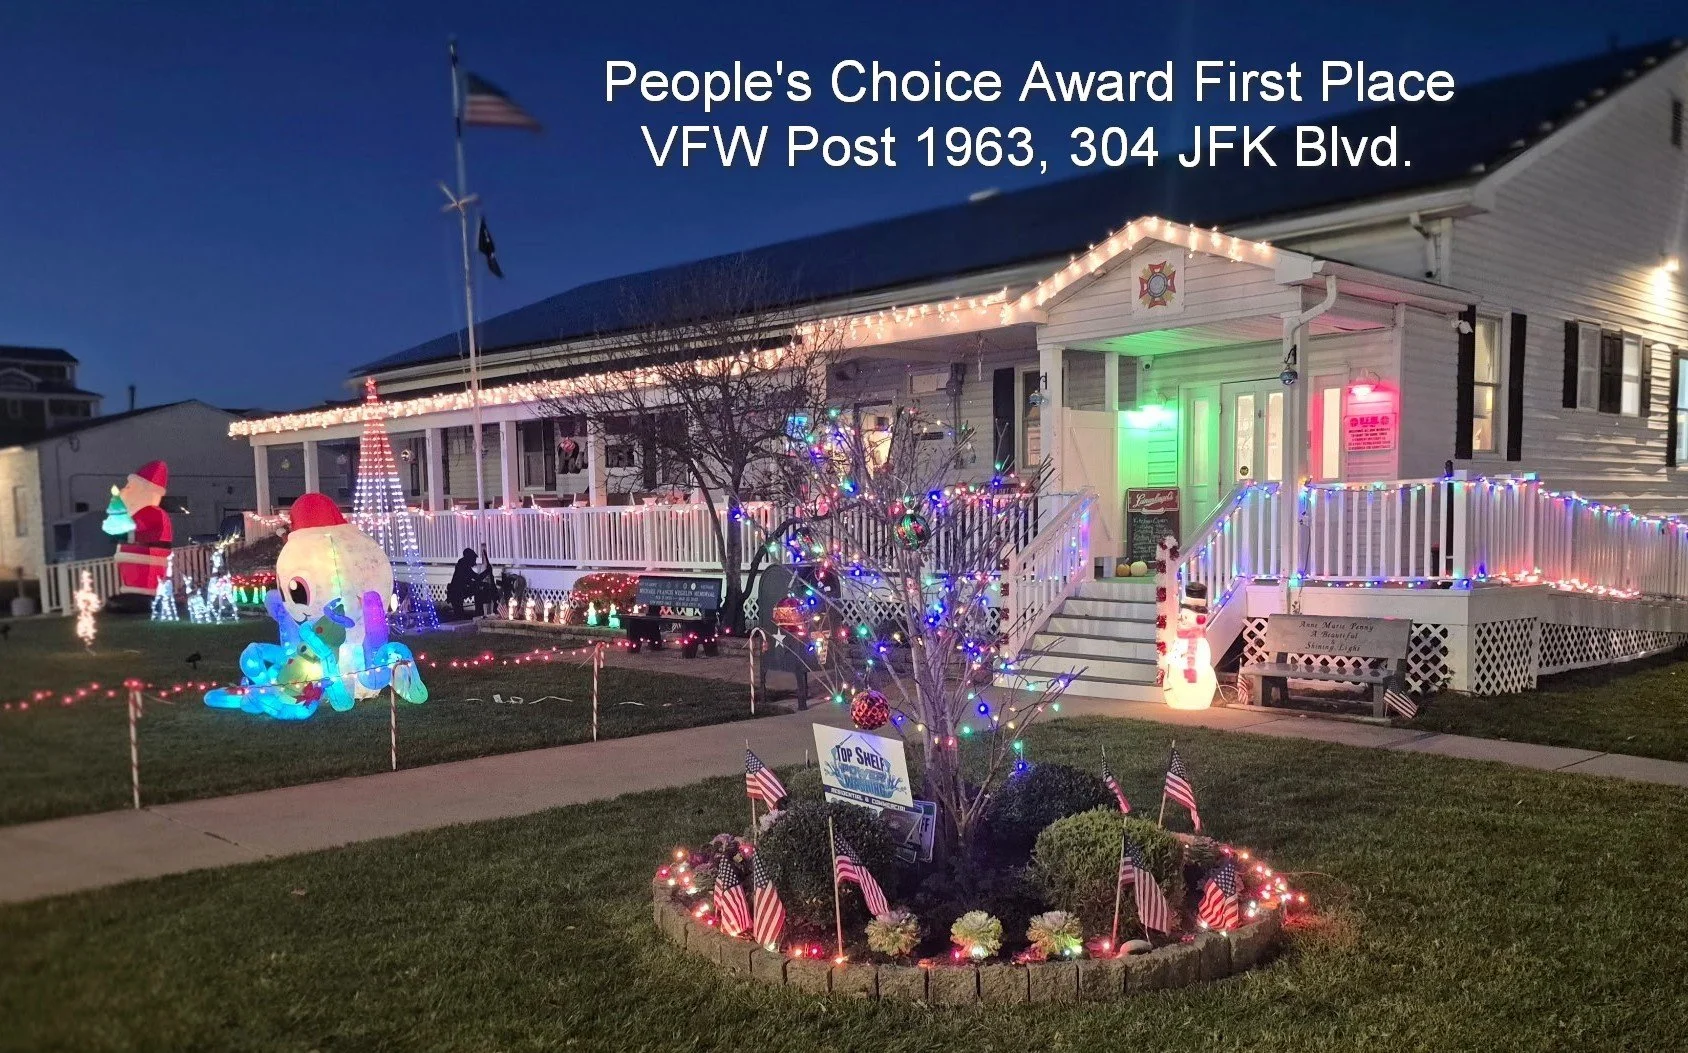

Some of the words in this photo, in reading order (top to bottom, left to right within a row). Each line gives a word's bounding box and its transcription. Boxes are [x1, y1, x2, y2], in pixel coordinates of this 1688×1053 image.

[1299, 620, 1318, 629] Anne
[1322, 621, 1346, 630] Marie
[1350, 623, 1375, 633] Penny
[1321, 630, 1359, 640] Beautiful
[1305, 643, 1335, 653] Shining
[1338, 644, 1361, 654] Light
[830, 787, 863, 801] RESIDENTIAL
